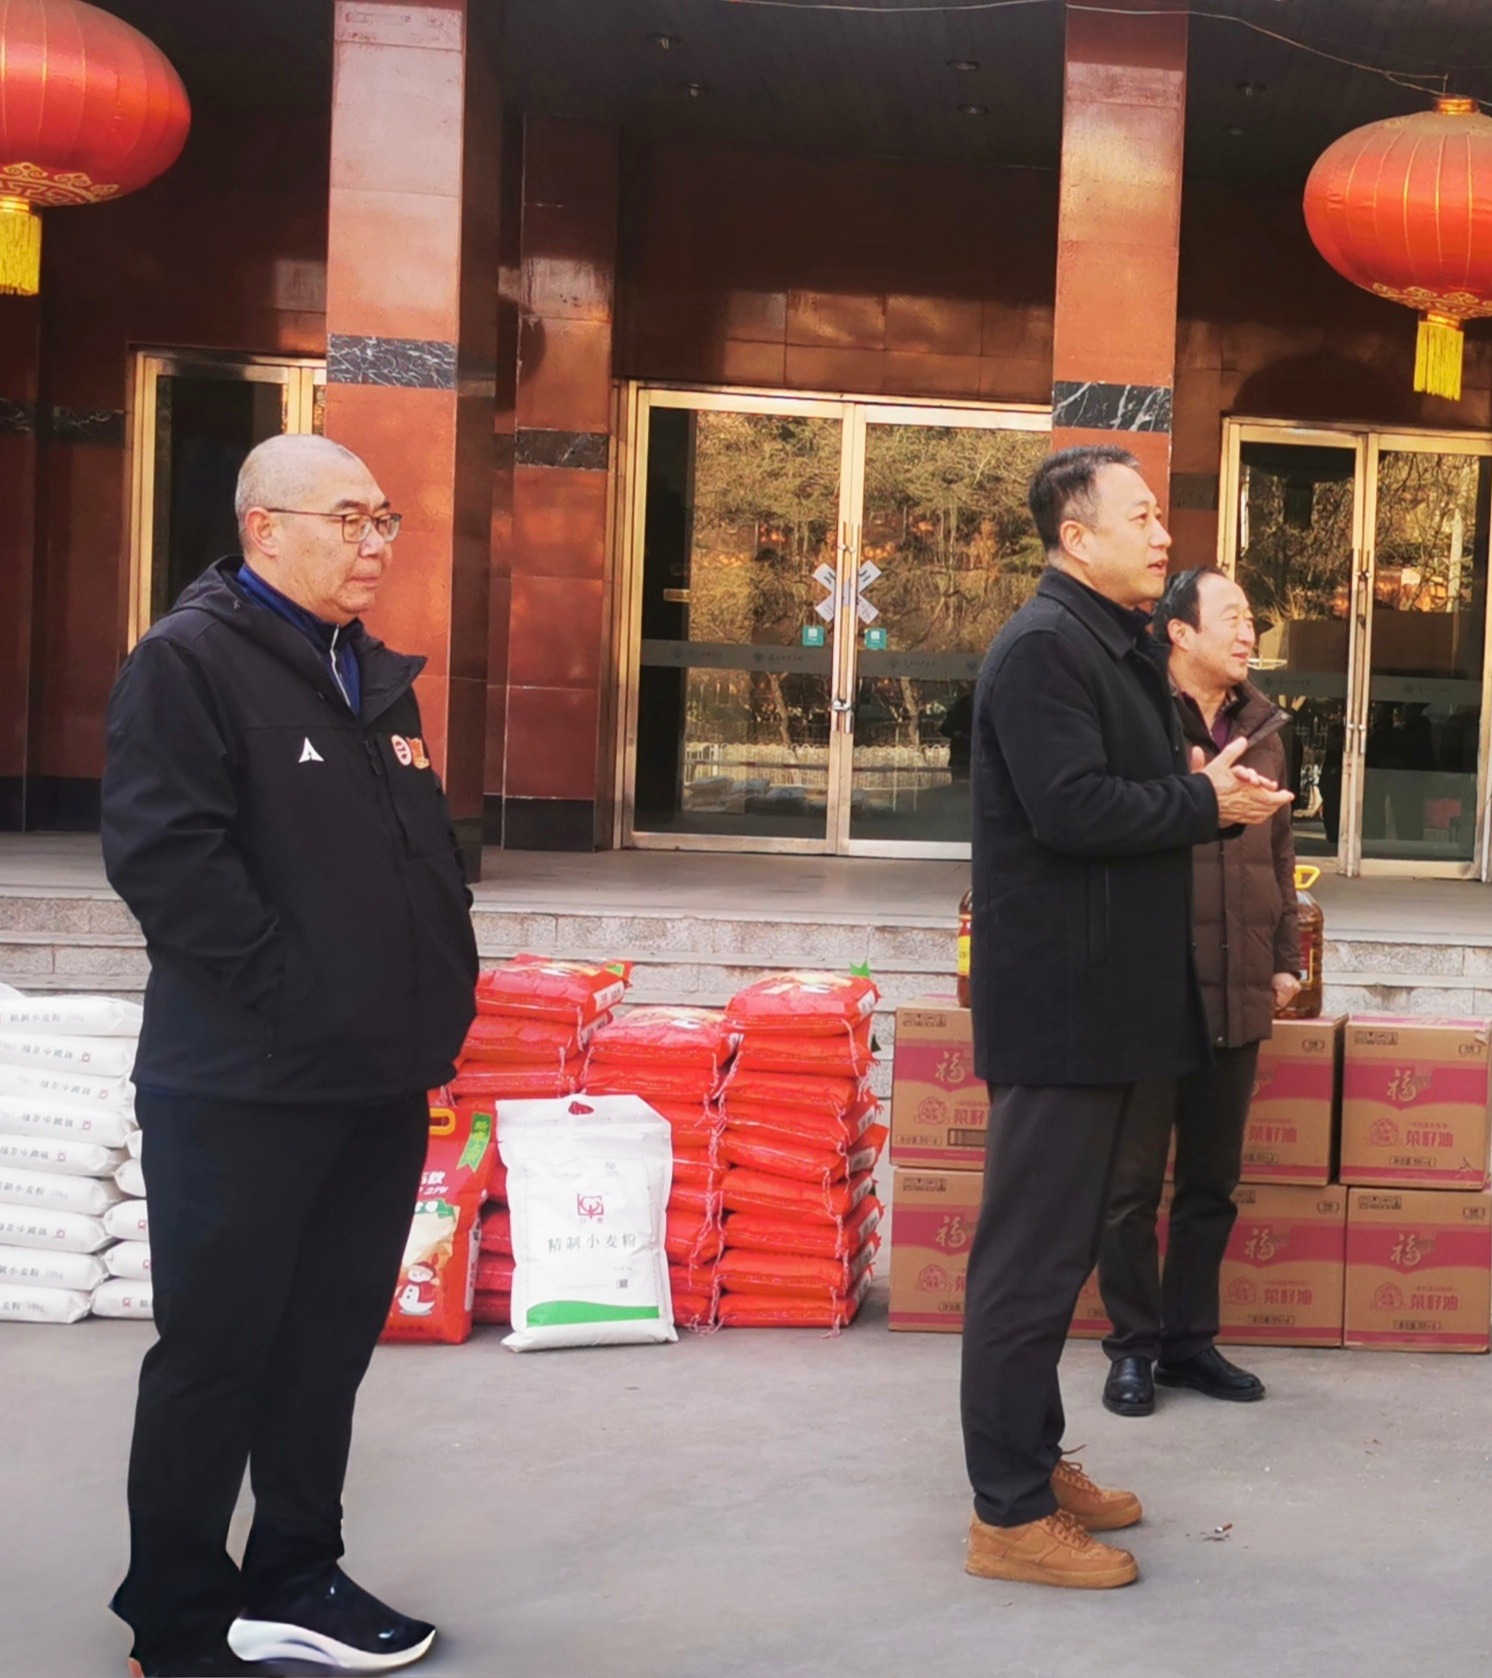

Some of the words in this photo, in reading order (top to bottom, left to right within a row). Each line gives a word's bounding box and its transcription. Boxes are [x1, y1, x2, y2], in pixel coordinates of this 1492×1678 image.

[935, 1050, 967, 1083] 福
[1386, 1068, 1418, 1103] 福
[1406, 1129, 1454, 1148] 菜籽油
[547, 1233, 637, 1254] 精制小麦粉
[935, 1215, 967, 1248] 福
[1245, 1227, 1276, 1260] 福
[1390, 1233, 1422, 1266] 福
